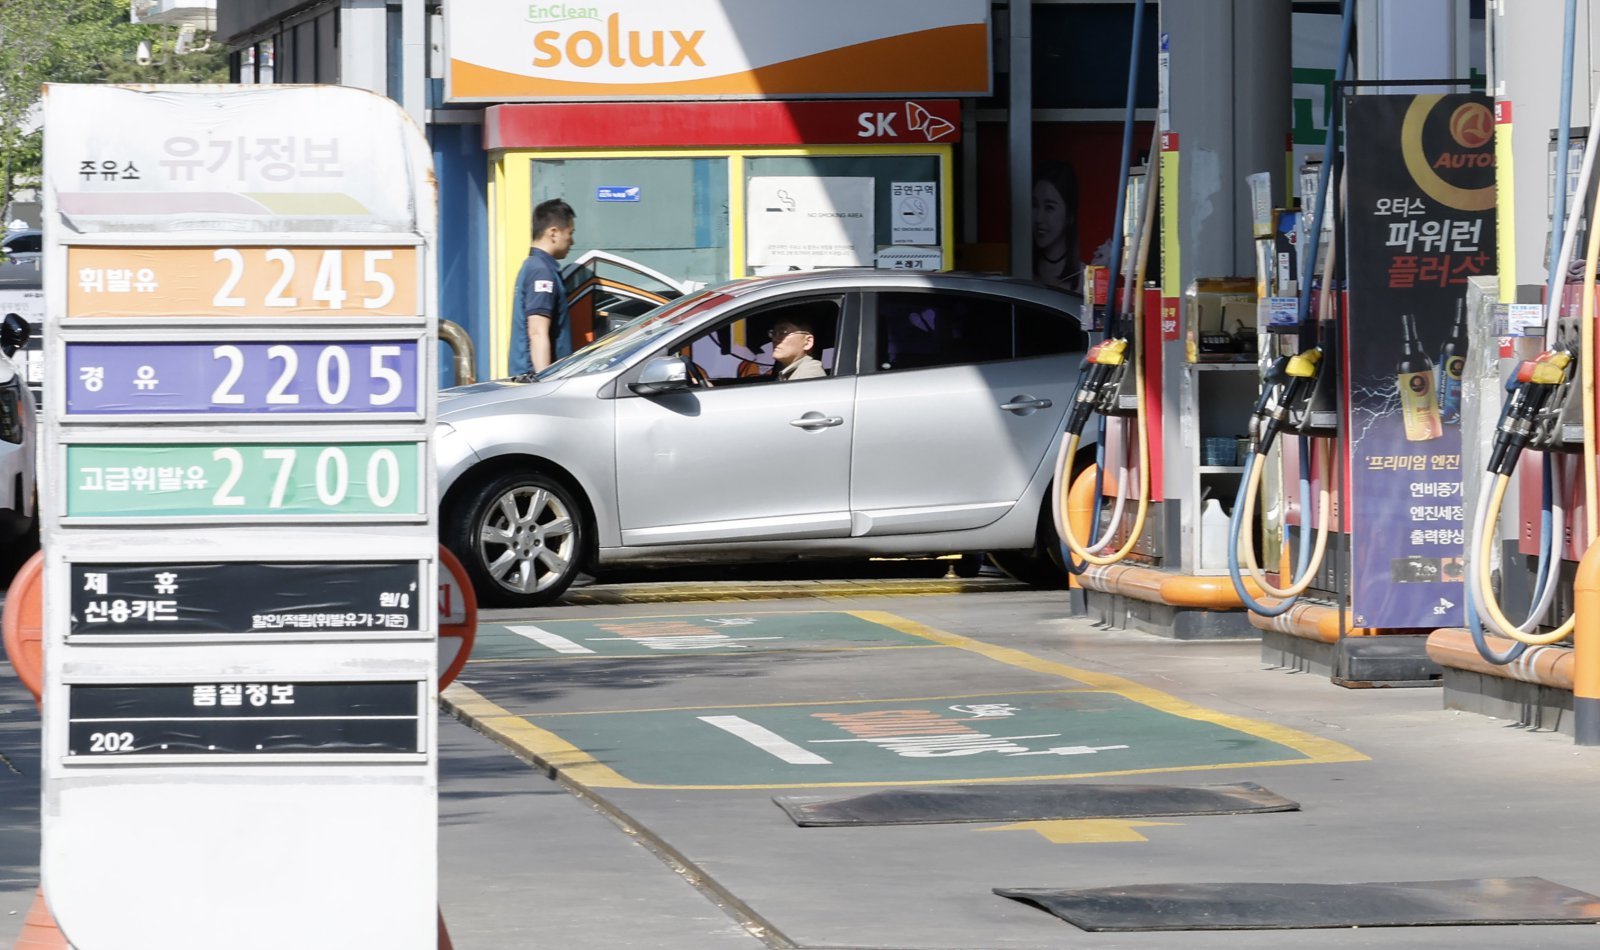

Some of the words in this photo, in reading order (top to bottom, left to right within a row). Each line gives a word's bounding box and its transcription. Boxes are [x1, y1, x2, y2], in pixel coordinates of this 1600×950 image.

[527, 4, 599, 19] EnClean
[532, 12, 706, 68] solux
[857, 112, 898, 138] SK
[79, 160, 141, 181] 주유소
[159, 135, 345, 182] 유가정보
[893, 185, 935, 196] 금연구역
[1373, 197, 1426, 218] 오터스
[1385, 219, 1483, 253] 파워런
[78, 267, 159, 293] 휘발유
[212, 248, 396, 310] 2245
[211, 345, 402, 405] 2205
[1431, 454, 1461, 471] 엔진
[79, 465, 209, 492] 고급휘발유
[212, 447, 401, 508] 2700
[83, 599, 180, 623] 신용카드
[192, 684, 296, 707] 품질정보
[89, 732, 135, 753] 202
